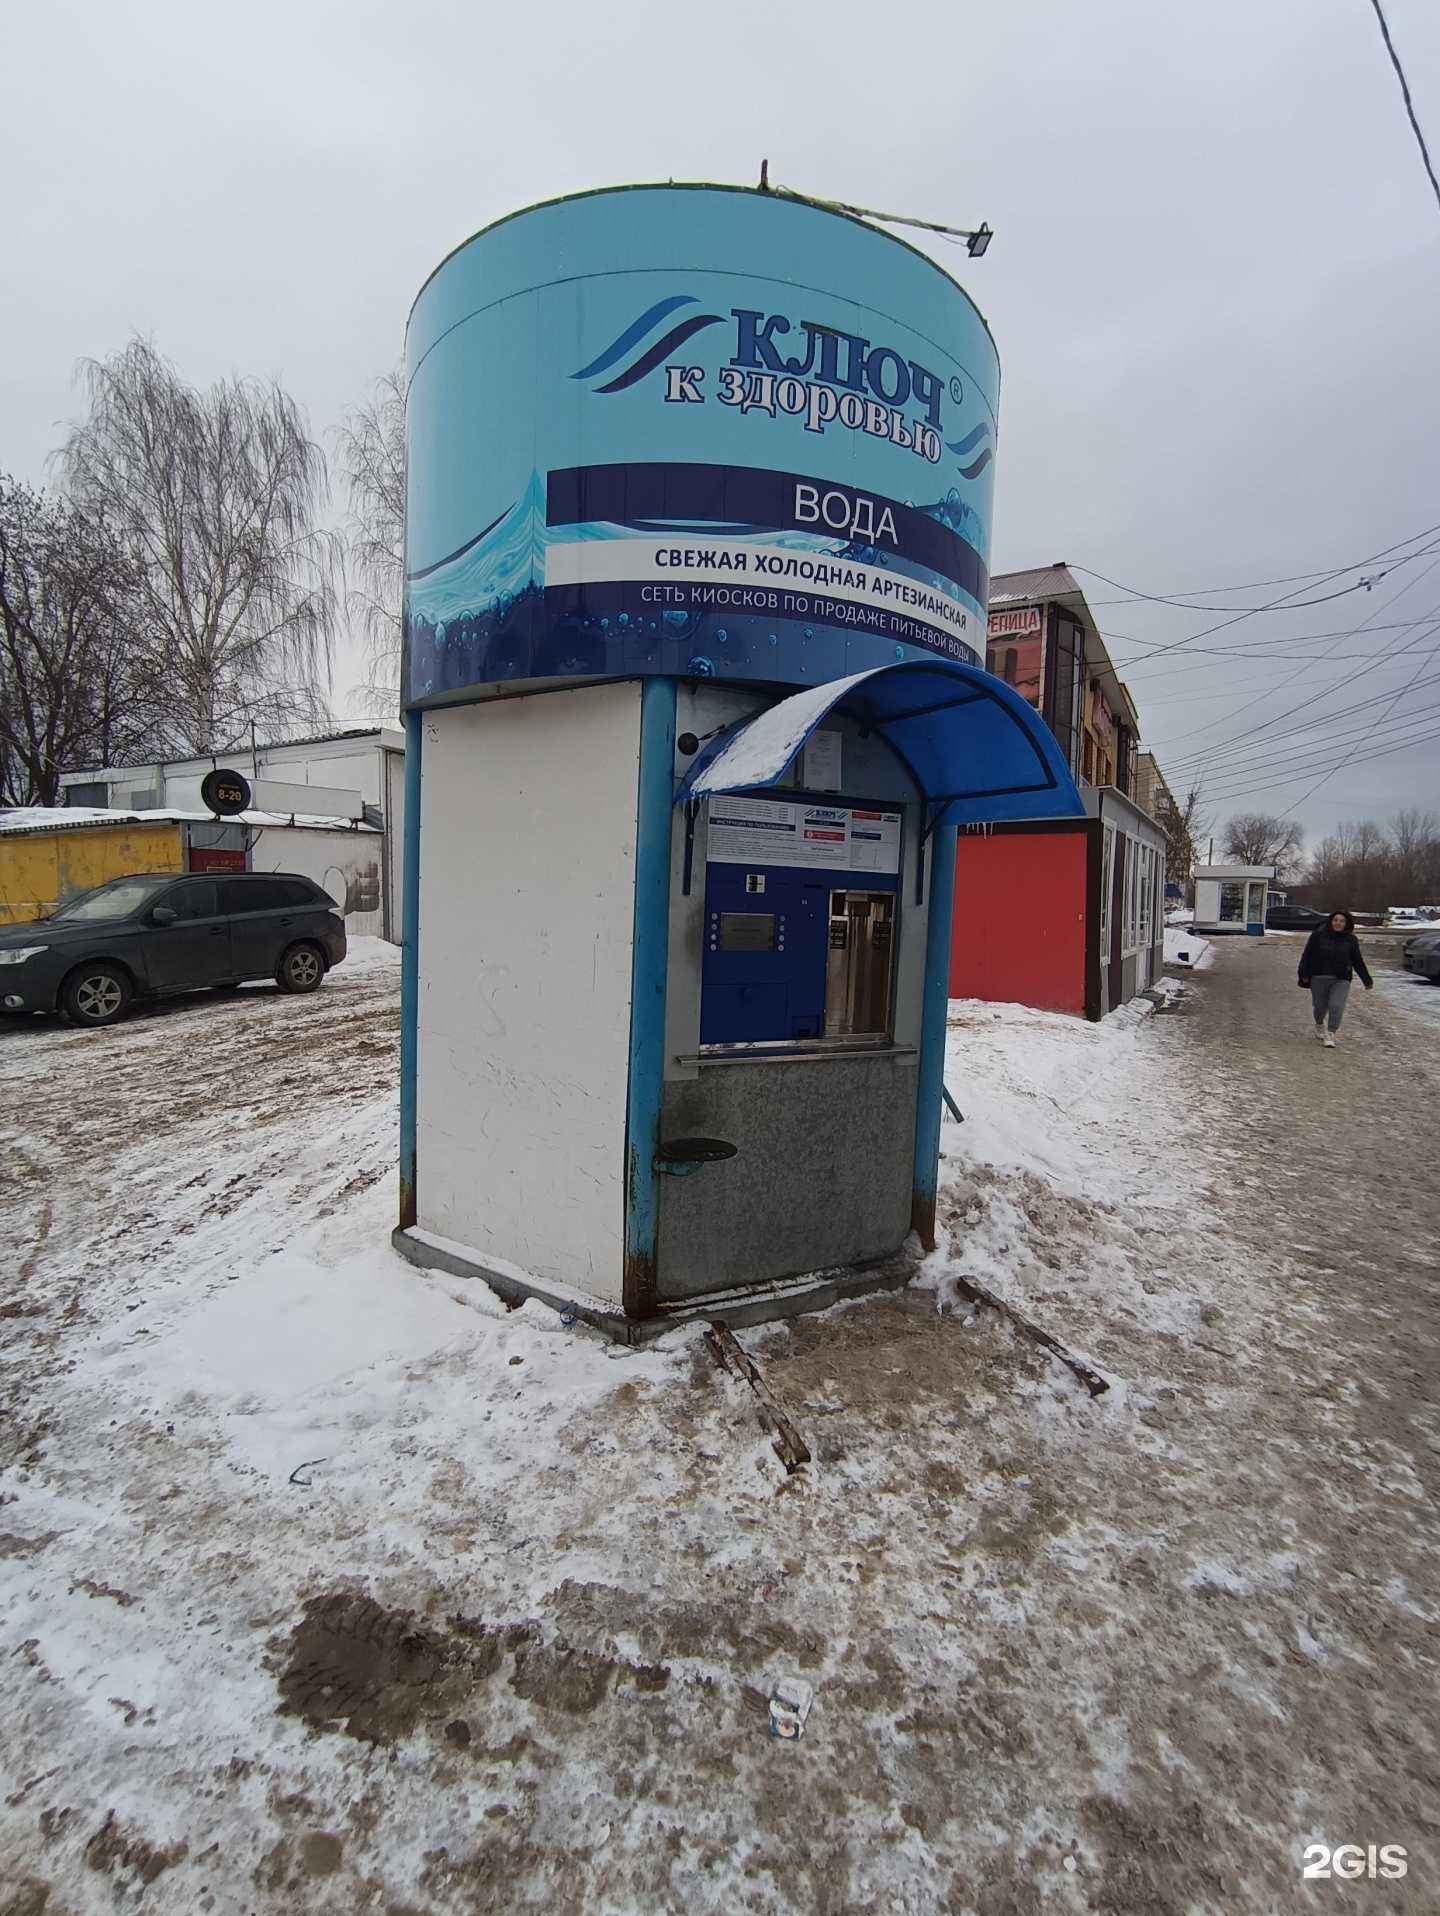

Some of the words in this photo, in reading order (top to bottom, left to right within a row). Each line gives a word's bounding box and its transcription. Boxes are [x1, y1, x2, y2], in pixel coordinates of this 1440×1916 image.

[729, 308, 945, 432] КЛЮЧ
[718, 367, 942, 464] здоровью
[794, 484, 899, 545] ВОДА
[641, 586, 685, 602] СЕТЬ
[691, 587, 778, 609] КИОСКОВ
[784, 594, 809, 612] ПО
[814, 598, 887, 629] ПРОДАЖЕ
[890, 616, 947, 650] ПИТЬЕВОЙ
[948, 640, 970, 663] ВОДЫ
[655, 548, 747, 571] СВЕЖАЯ
[754, 555, 866, 591] ХОЛОДНАЯ
[871, 576, 967, 630] АРТЕЗИАНСКАЯ
[218, 789, 242, 801] 8-20
